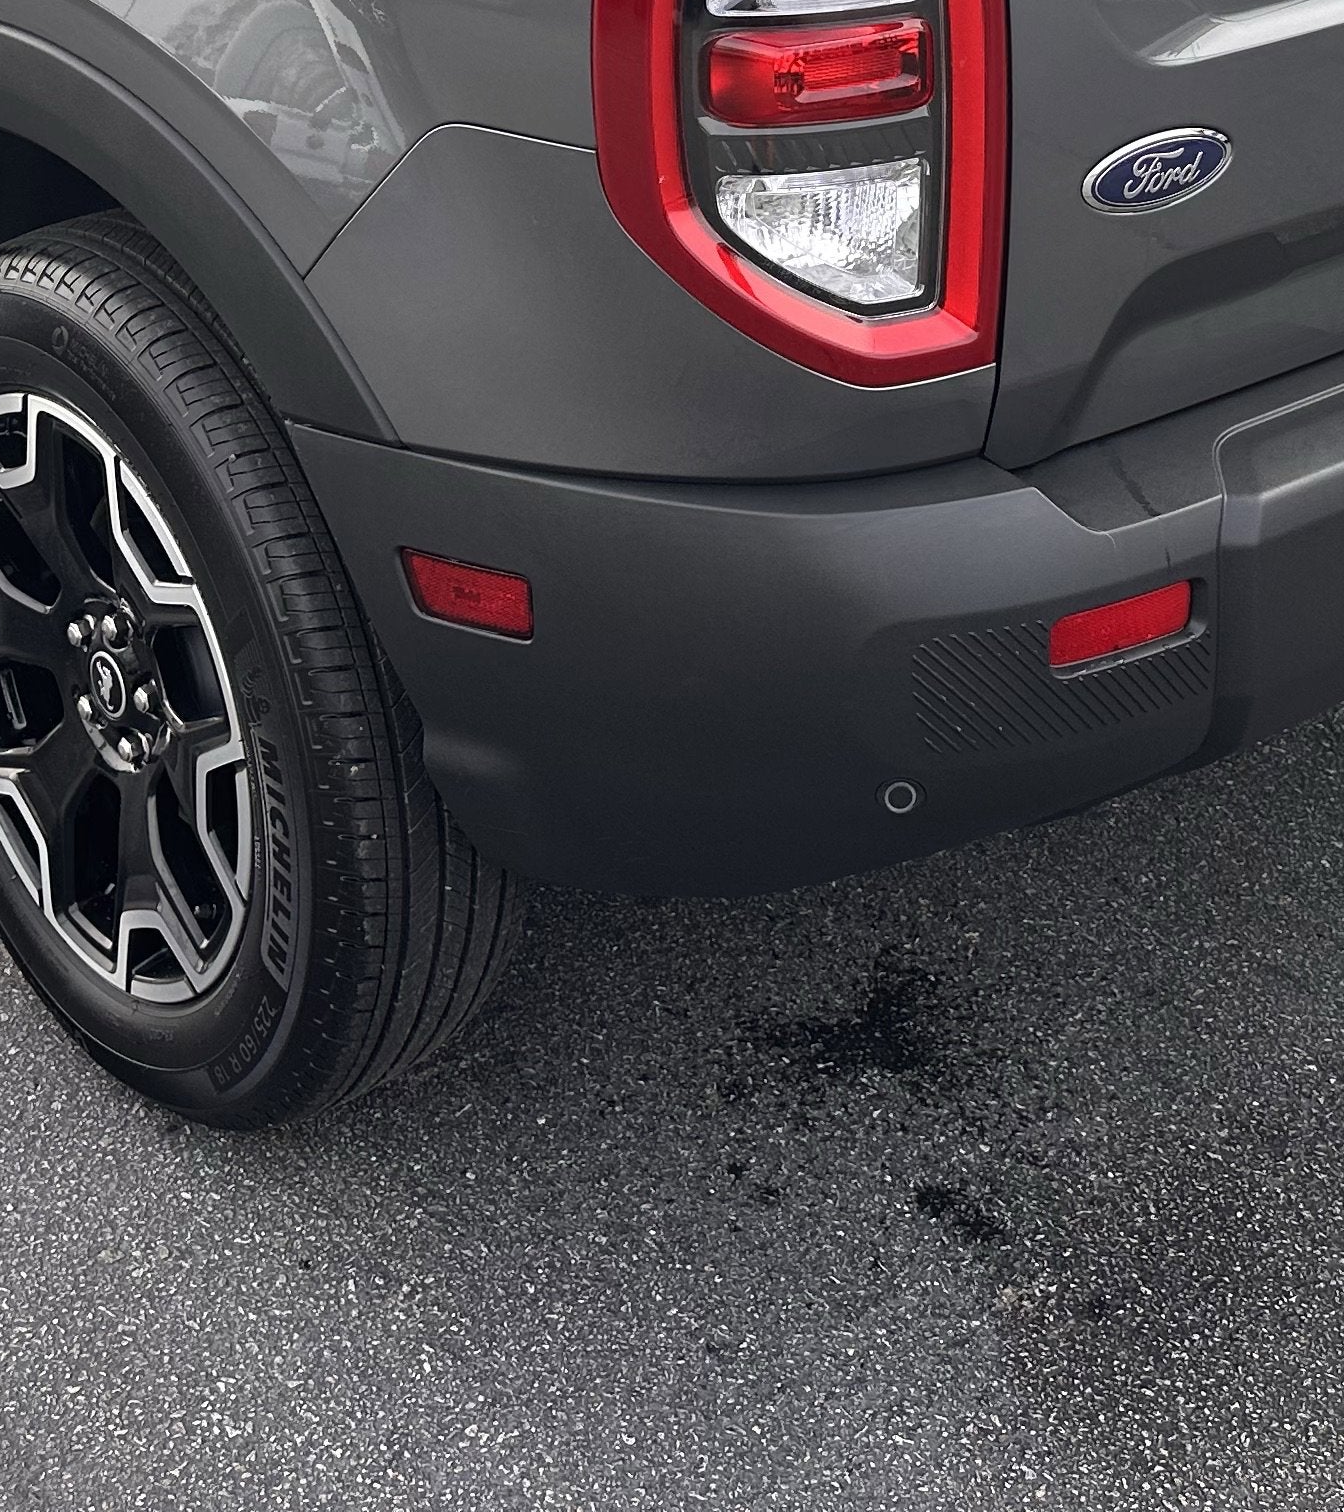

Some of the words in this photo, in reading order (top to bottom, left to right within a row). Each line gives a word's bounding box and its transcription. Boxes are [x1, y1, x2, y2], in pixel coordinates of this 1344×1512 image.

[1123, 147, 1204, 199] Ford
[257, 737, 292, 976] MICHELIN
[238, 995, 278, 1063] 225/60
